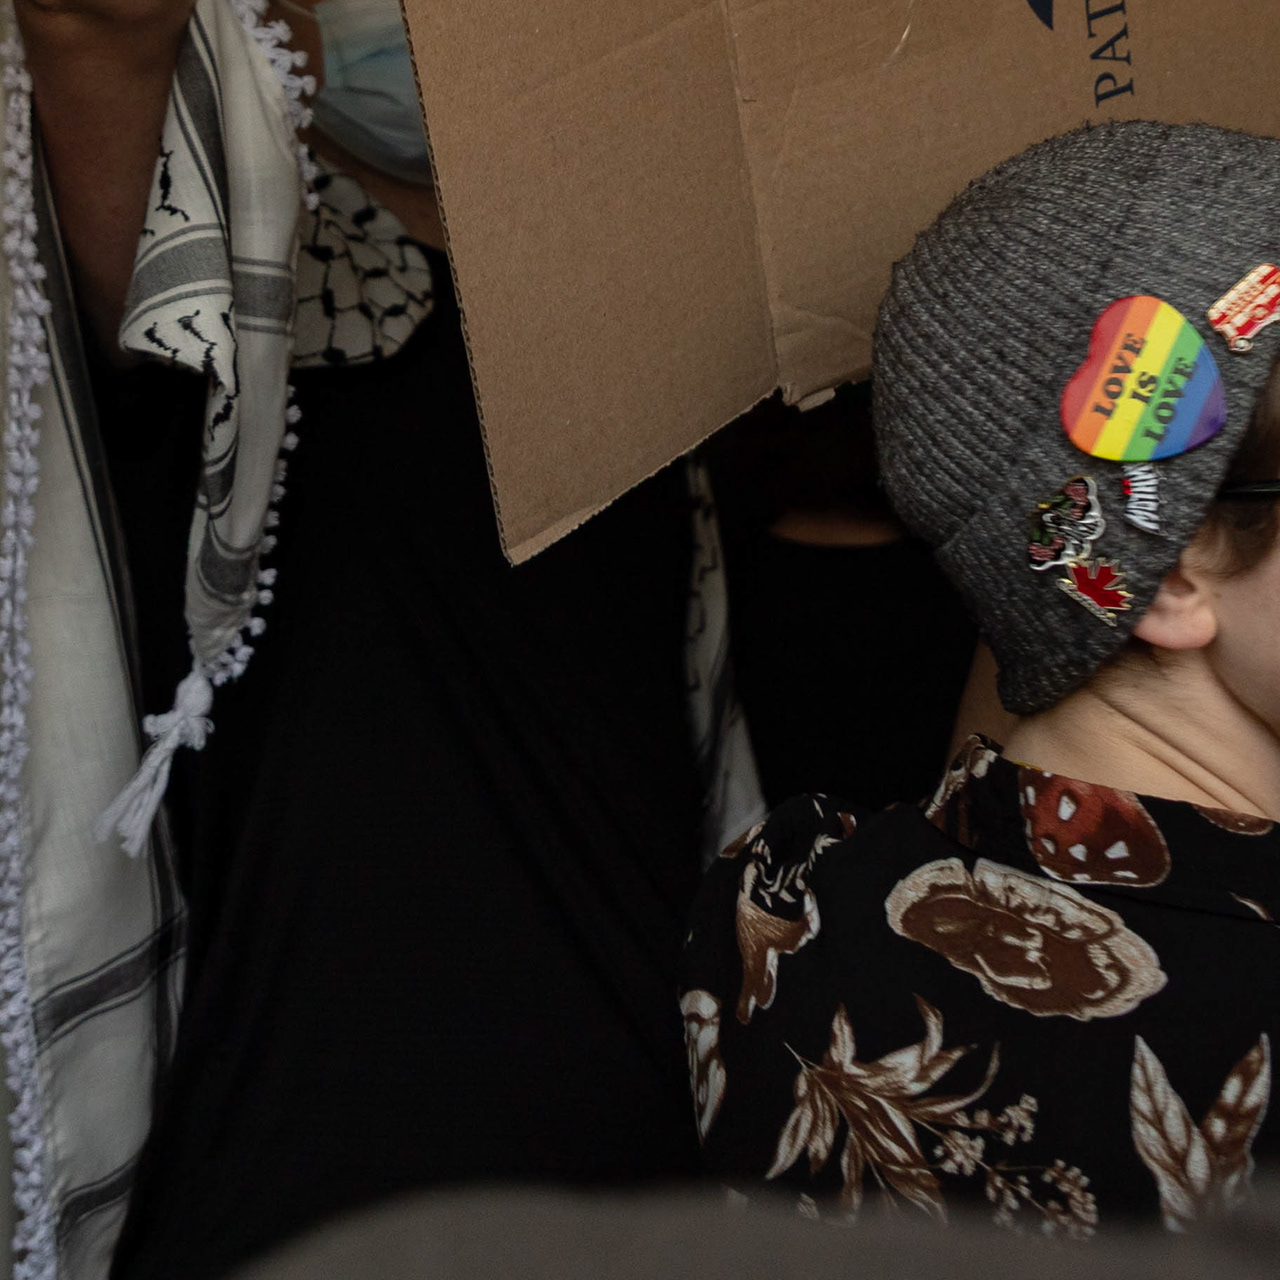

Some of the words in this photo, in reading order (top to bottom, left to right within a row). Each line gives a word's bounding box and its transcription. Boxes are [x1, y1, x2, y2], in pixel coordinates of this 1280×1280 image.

[1092, 332, 1147, 420] LOVE
[1130, 371, 1159, 406] IS
[1141, 357, 1197, 443] LOVE
